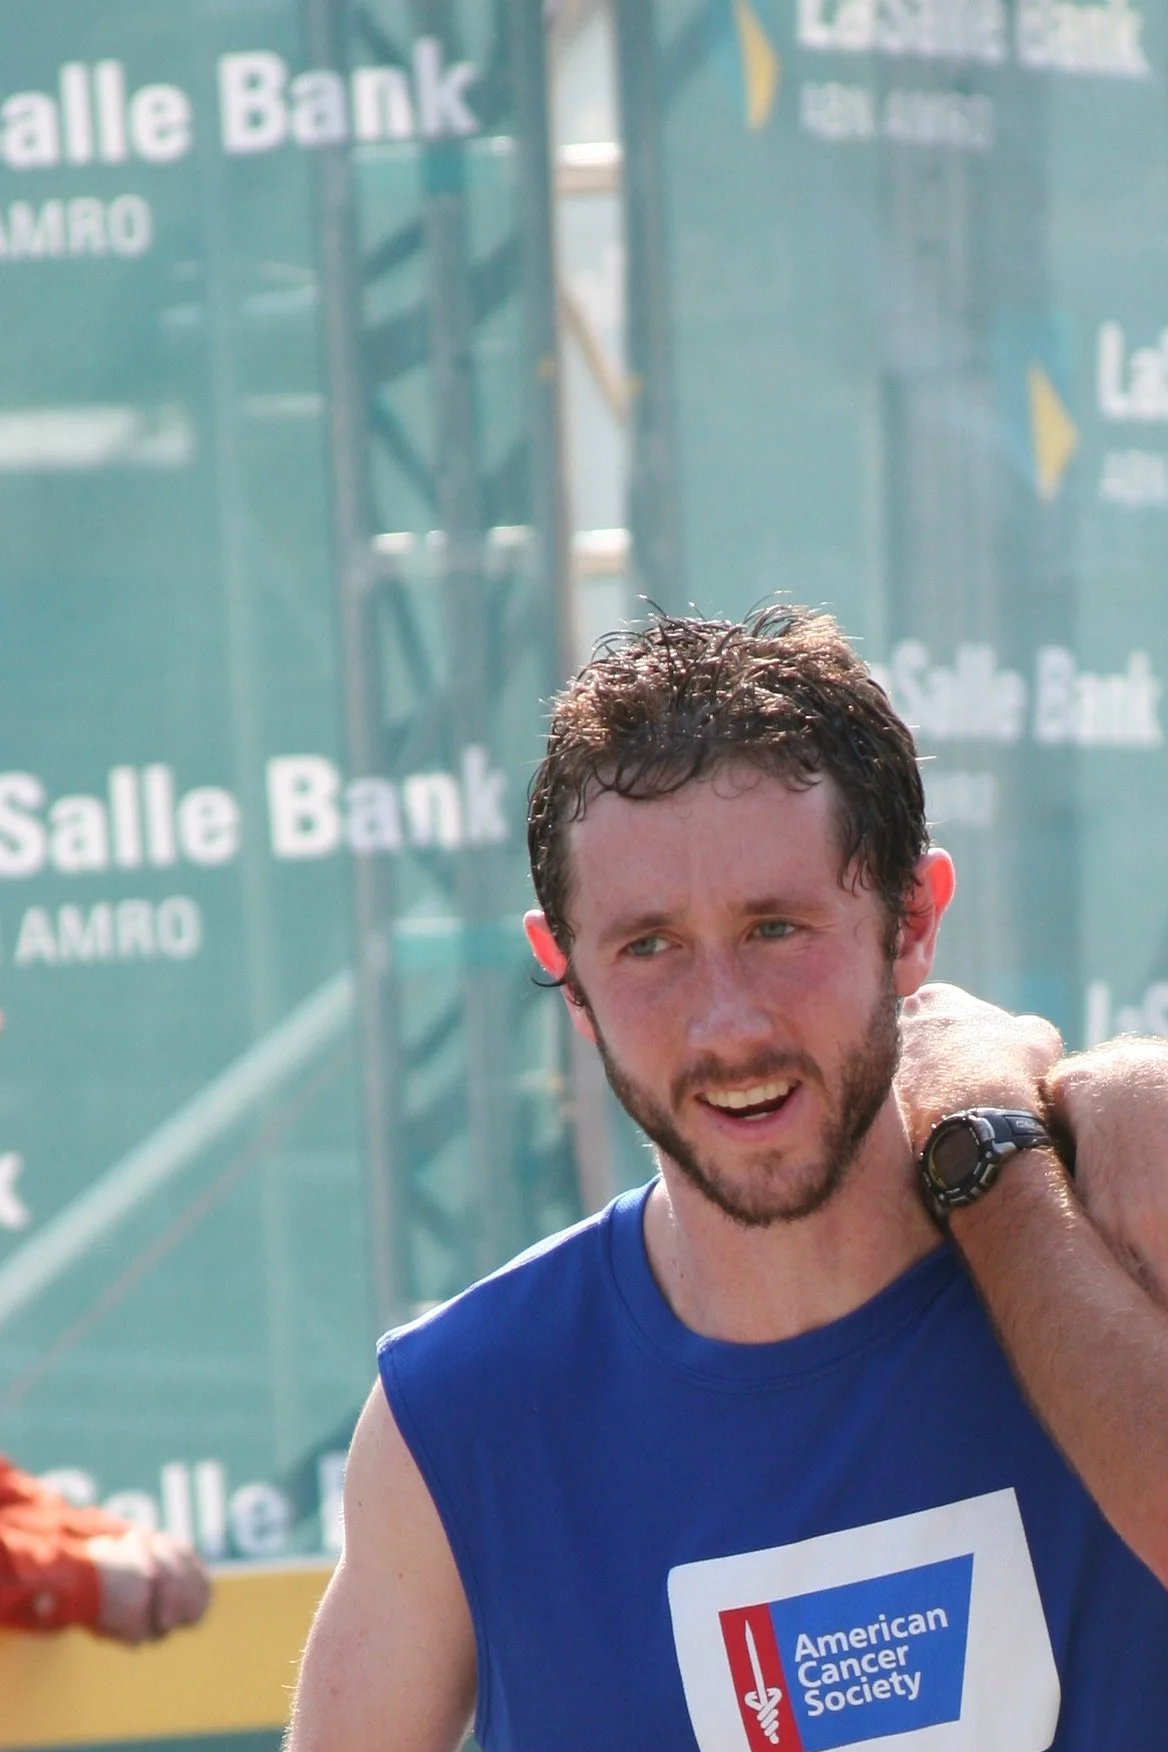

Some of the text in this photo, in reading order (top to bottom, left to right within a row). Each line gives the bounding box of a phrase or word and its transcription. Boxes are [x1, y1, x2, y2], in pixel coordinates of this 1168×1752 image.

[217, 36, 478, 154] Bank
[0, 743, 506, 877] Salle Bank
[15, 895, 203, 967] AMRO
[794, 1607, 949, 1663] American
[797, 1644, 909, 1689] Cancer
[803, 1670, 922, 1718] Society
